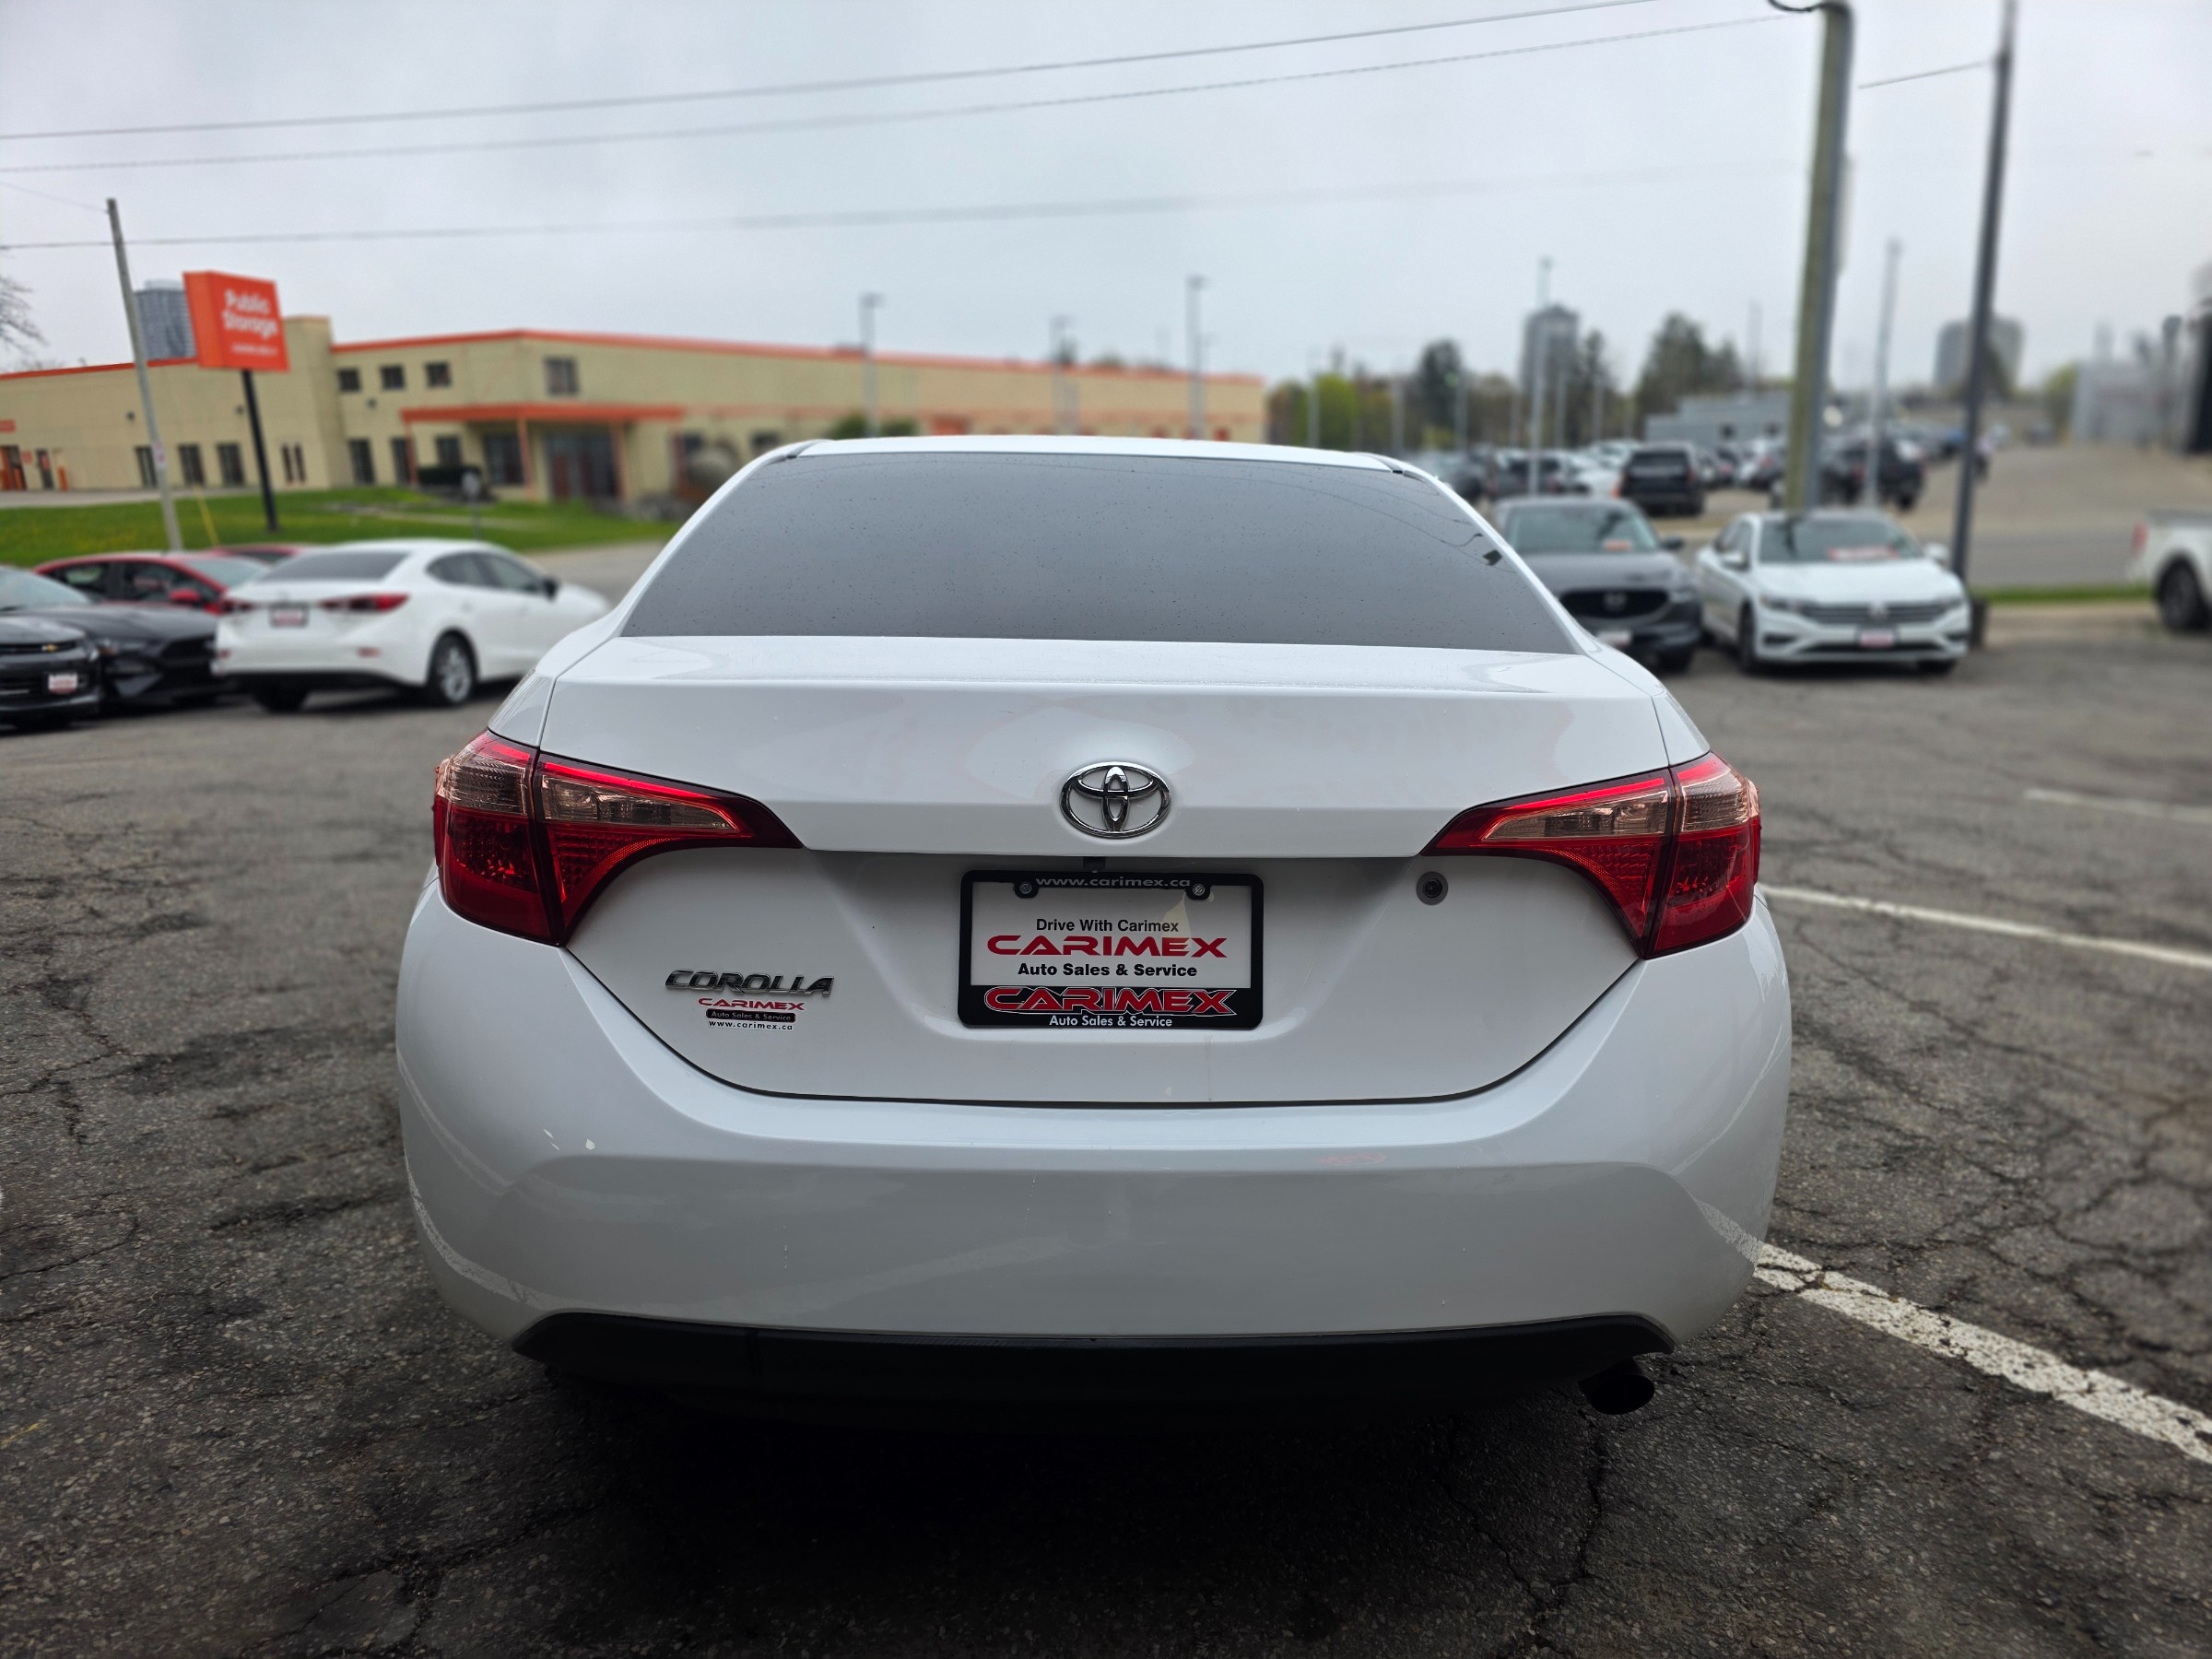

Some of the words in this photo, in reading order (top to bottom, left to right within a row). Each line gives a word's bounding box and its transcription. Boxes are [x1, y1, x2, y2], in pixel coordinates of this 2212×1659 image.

[1035, 877, 1191, 888] www.carimex.ca
[1036, 919, 1075, 931] Drive
[1079, 919, 1112, 932] With
[1117, 919, 1179, 933] Carimex
[987, 935, 1228, 958] CARIMEX
[1018, 963, 1057, 976] Auto
[1063, 963, 1110, 976] Sales
[1115, 965, 1128, 976] &
[1134, 963, 1198, 977] Service
[665, 970, 835, 997] COROLLA
[698, 997, 806, 1011] CARIMEX
[984, 986, 1237, 1017] CARIMEX
[732, 1012, 752, 1020] Sales
[1049, 1015, 1077, 1027] Auto
[1082, 1016, 1113, 1027] Sales
[1118, 1018, 1125, 1027] &
[1129, 1016, 1173, 1028] Service
[709, 1020, 794, 1030] www.carimex.ca
